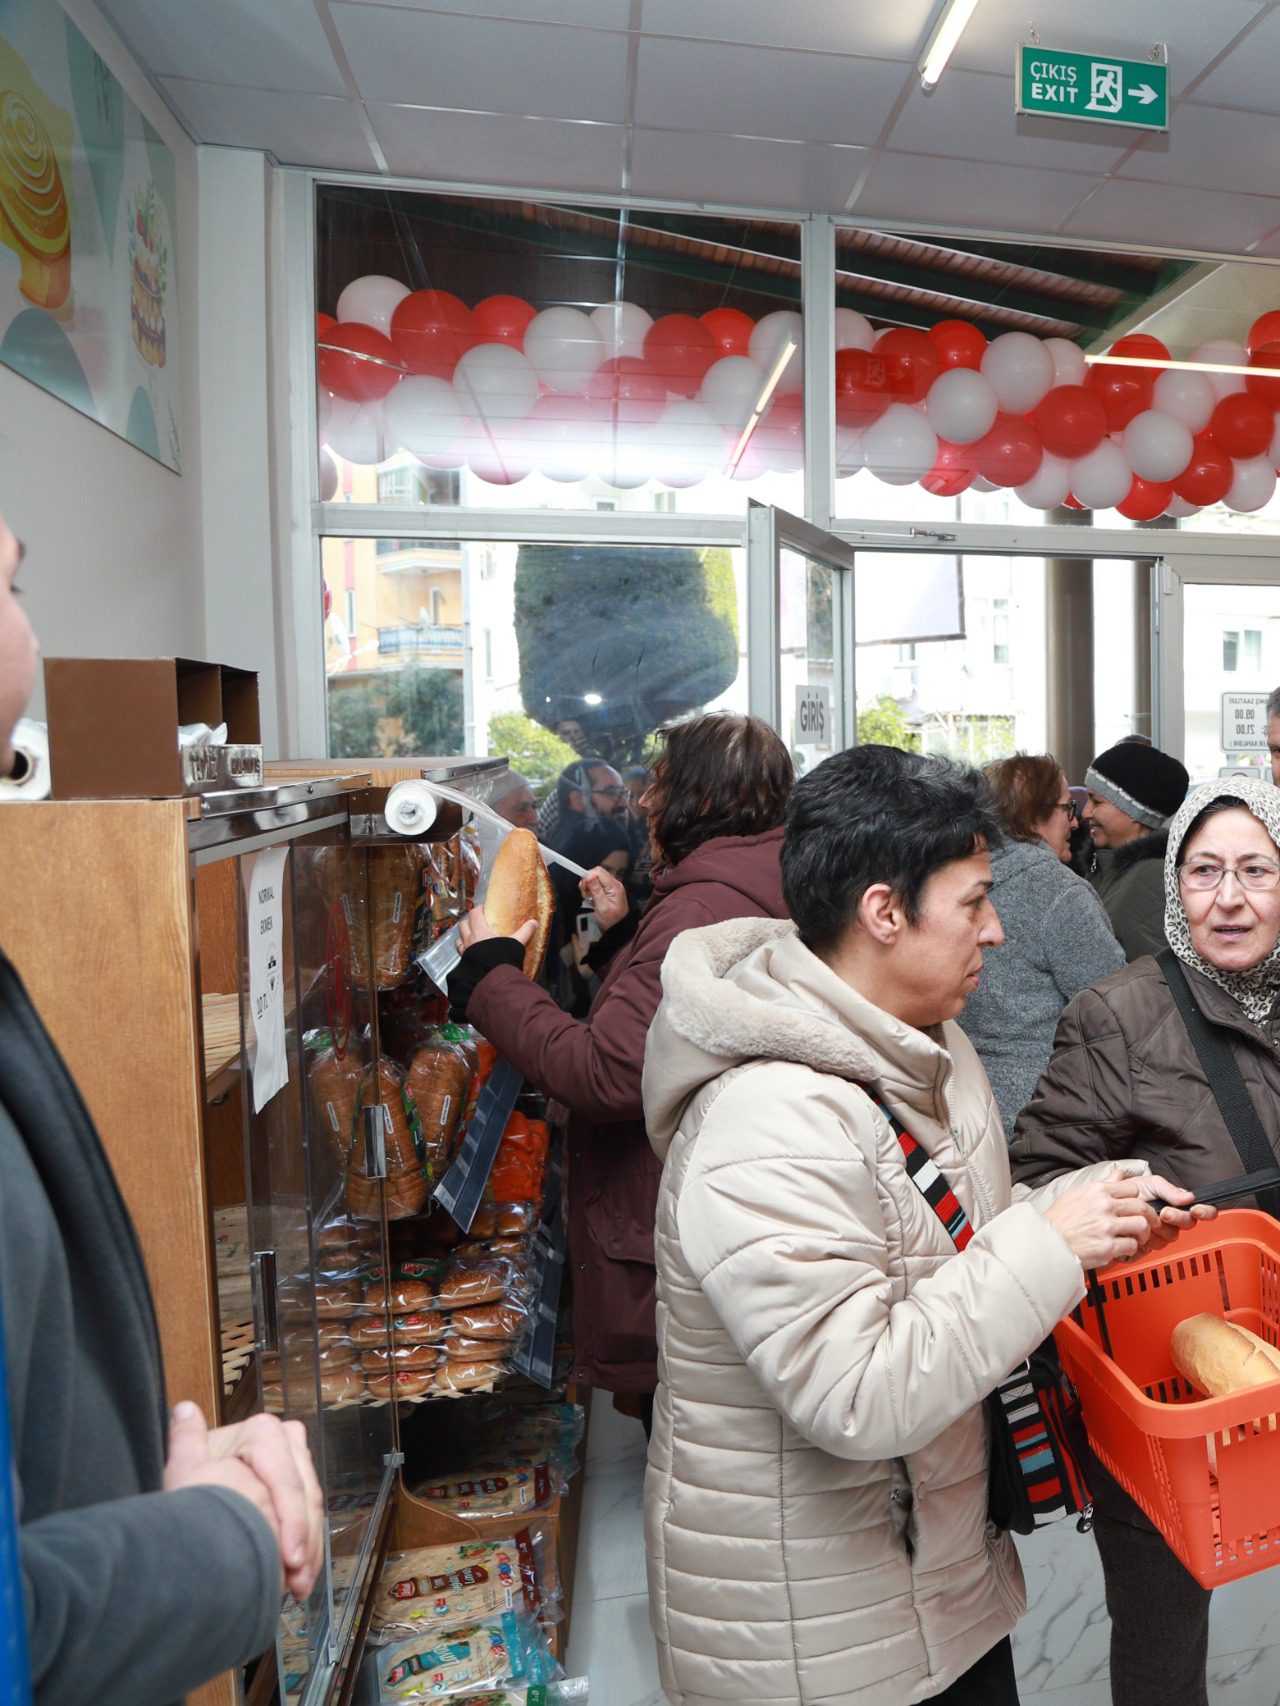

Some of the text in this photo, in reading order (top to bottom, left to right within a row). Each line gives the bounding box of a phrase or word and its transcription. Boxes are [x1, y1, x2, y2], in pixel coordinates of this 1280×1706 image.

[1030, 61, 1077, 85] ÇIKIŞ
[1031, 82, 1078, 103] EXIT
[800, 692, 825, 739] GİRİŞ
